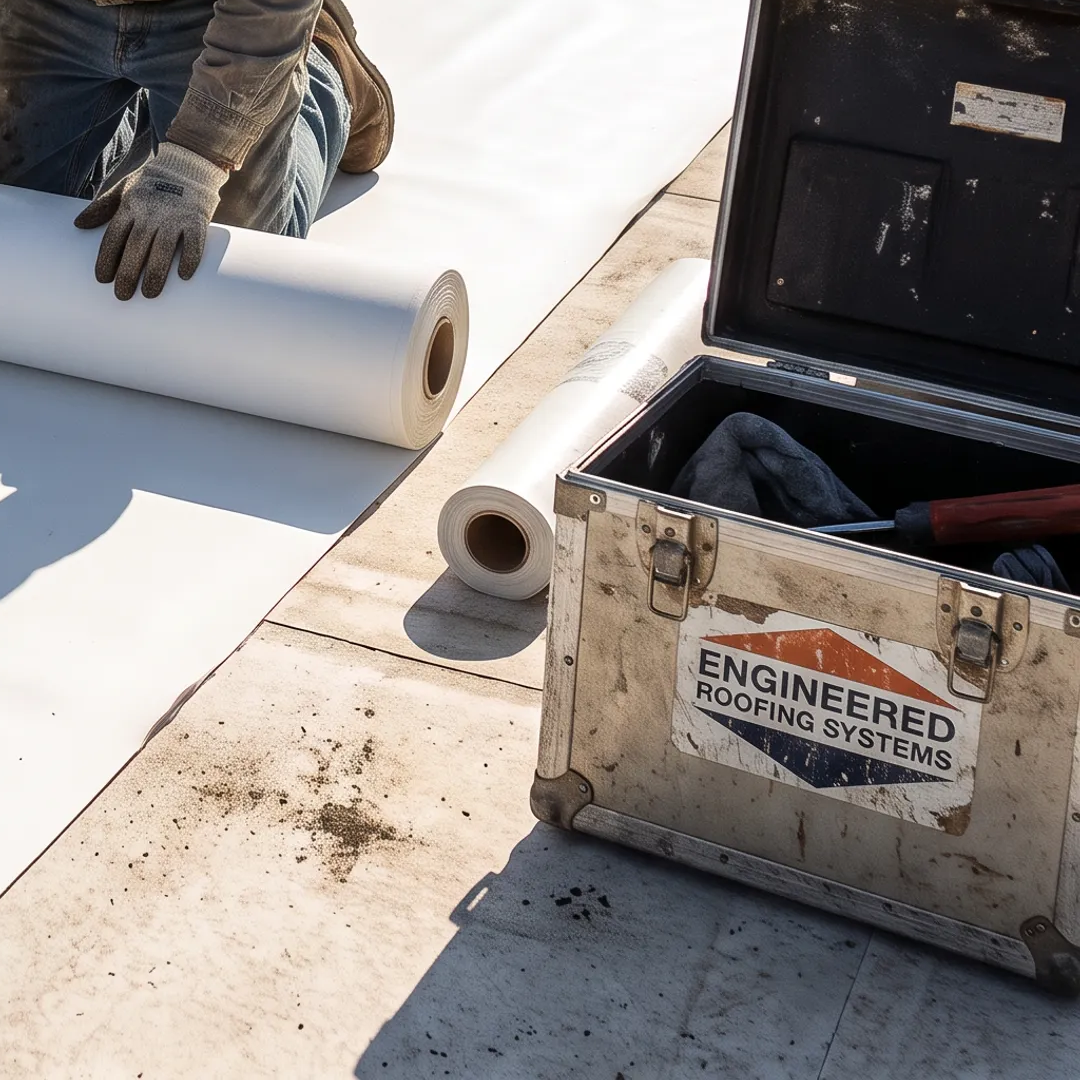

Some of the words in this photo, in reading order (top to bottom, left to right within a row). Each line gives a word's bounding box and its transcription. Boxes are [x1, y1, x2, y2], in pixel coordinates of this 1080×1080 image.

[696, 680, 815, 732] ROOFING
[822, 717, 954, 771] SYSTEMS
[698, 647, 956, 743] ENGINEERED
